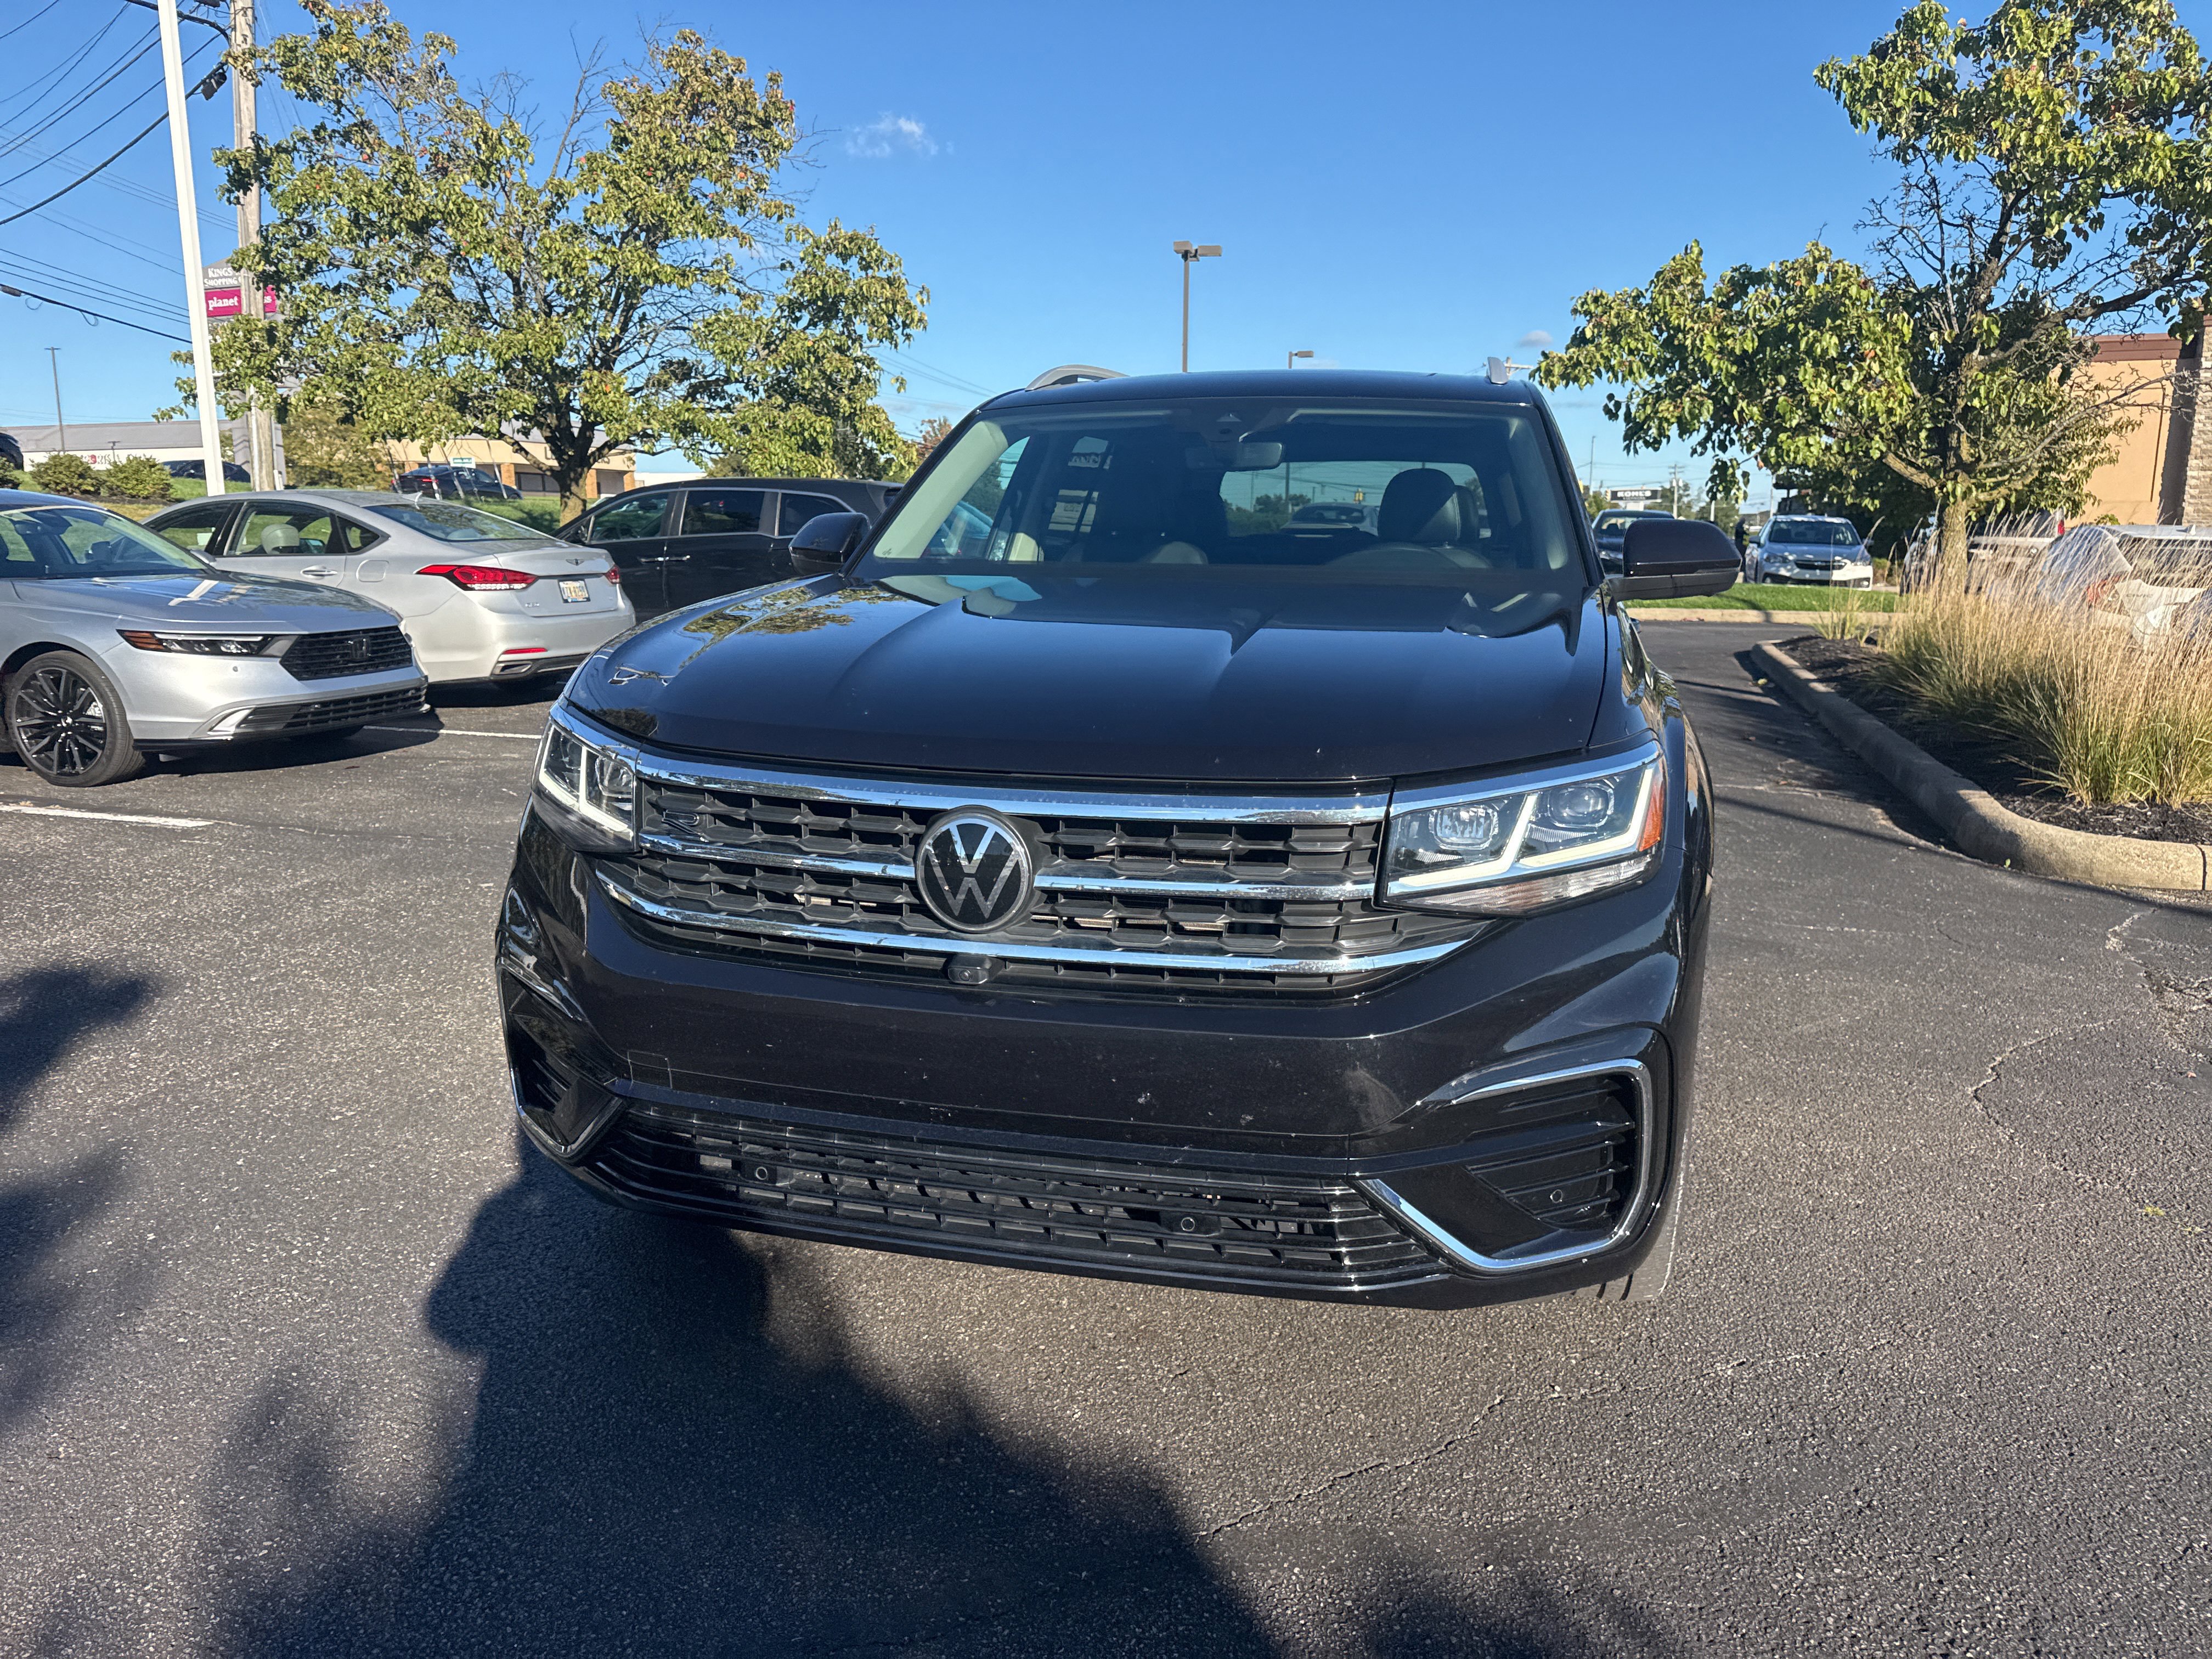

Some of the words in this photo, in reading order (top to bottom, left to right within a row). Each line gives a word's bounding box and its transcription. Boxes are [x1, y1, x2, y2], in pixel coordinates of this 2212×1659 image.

[208, 268, 233, 278] KINGS
[204, 277, 238, 286] SHOPPING
[208, 296, 239, 311] planet
